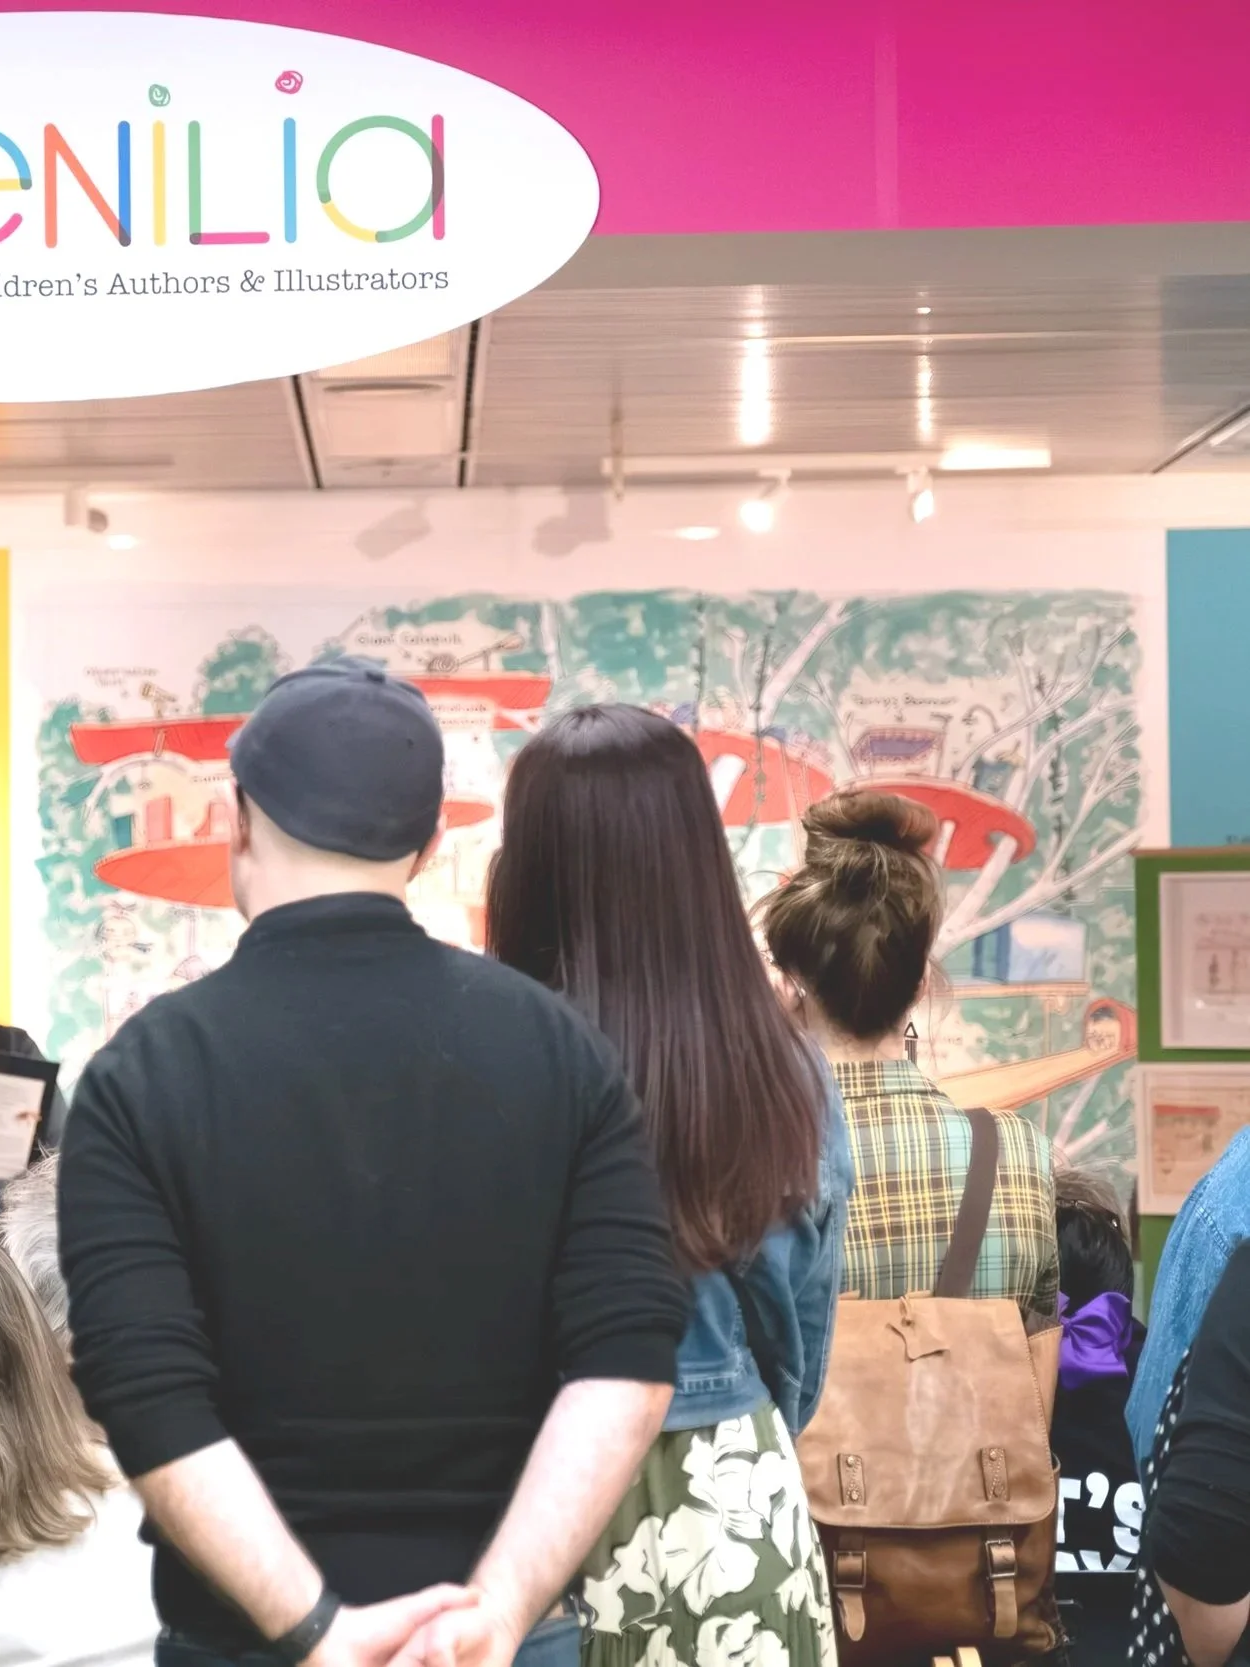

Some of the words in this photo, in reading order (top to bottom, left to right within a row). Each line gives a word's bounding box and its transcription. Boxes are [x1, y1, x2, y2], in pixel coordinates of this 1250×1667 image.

[105, 271, 230, 295] Authors
[239, 269, 266, 293] &
[272, 268, 449, 292] Illustrators
